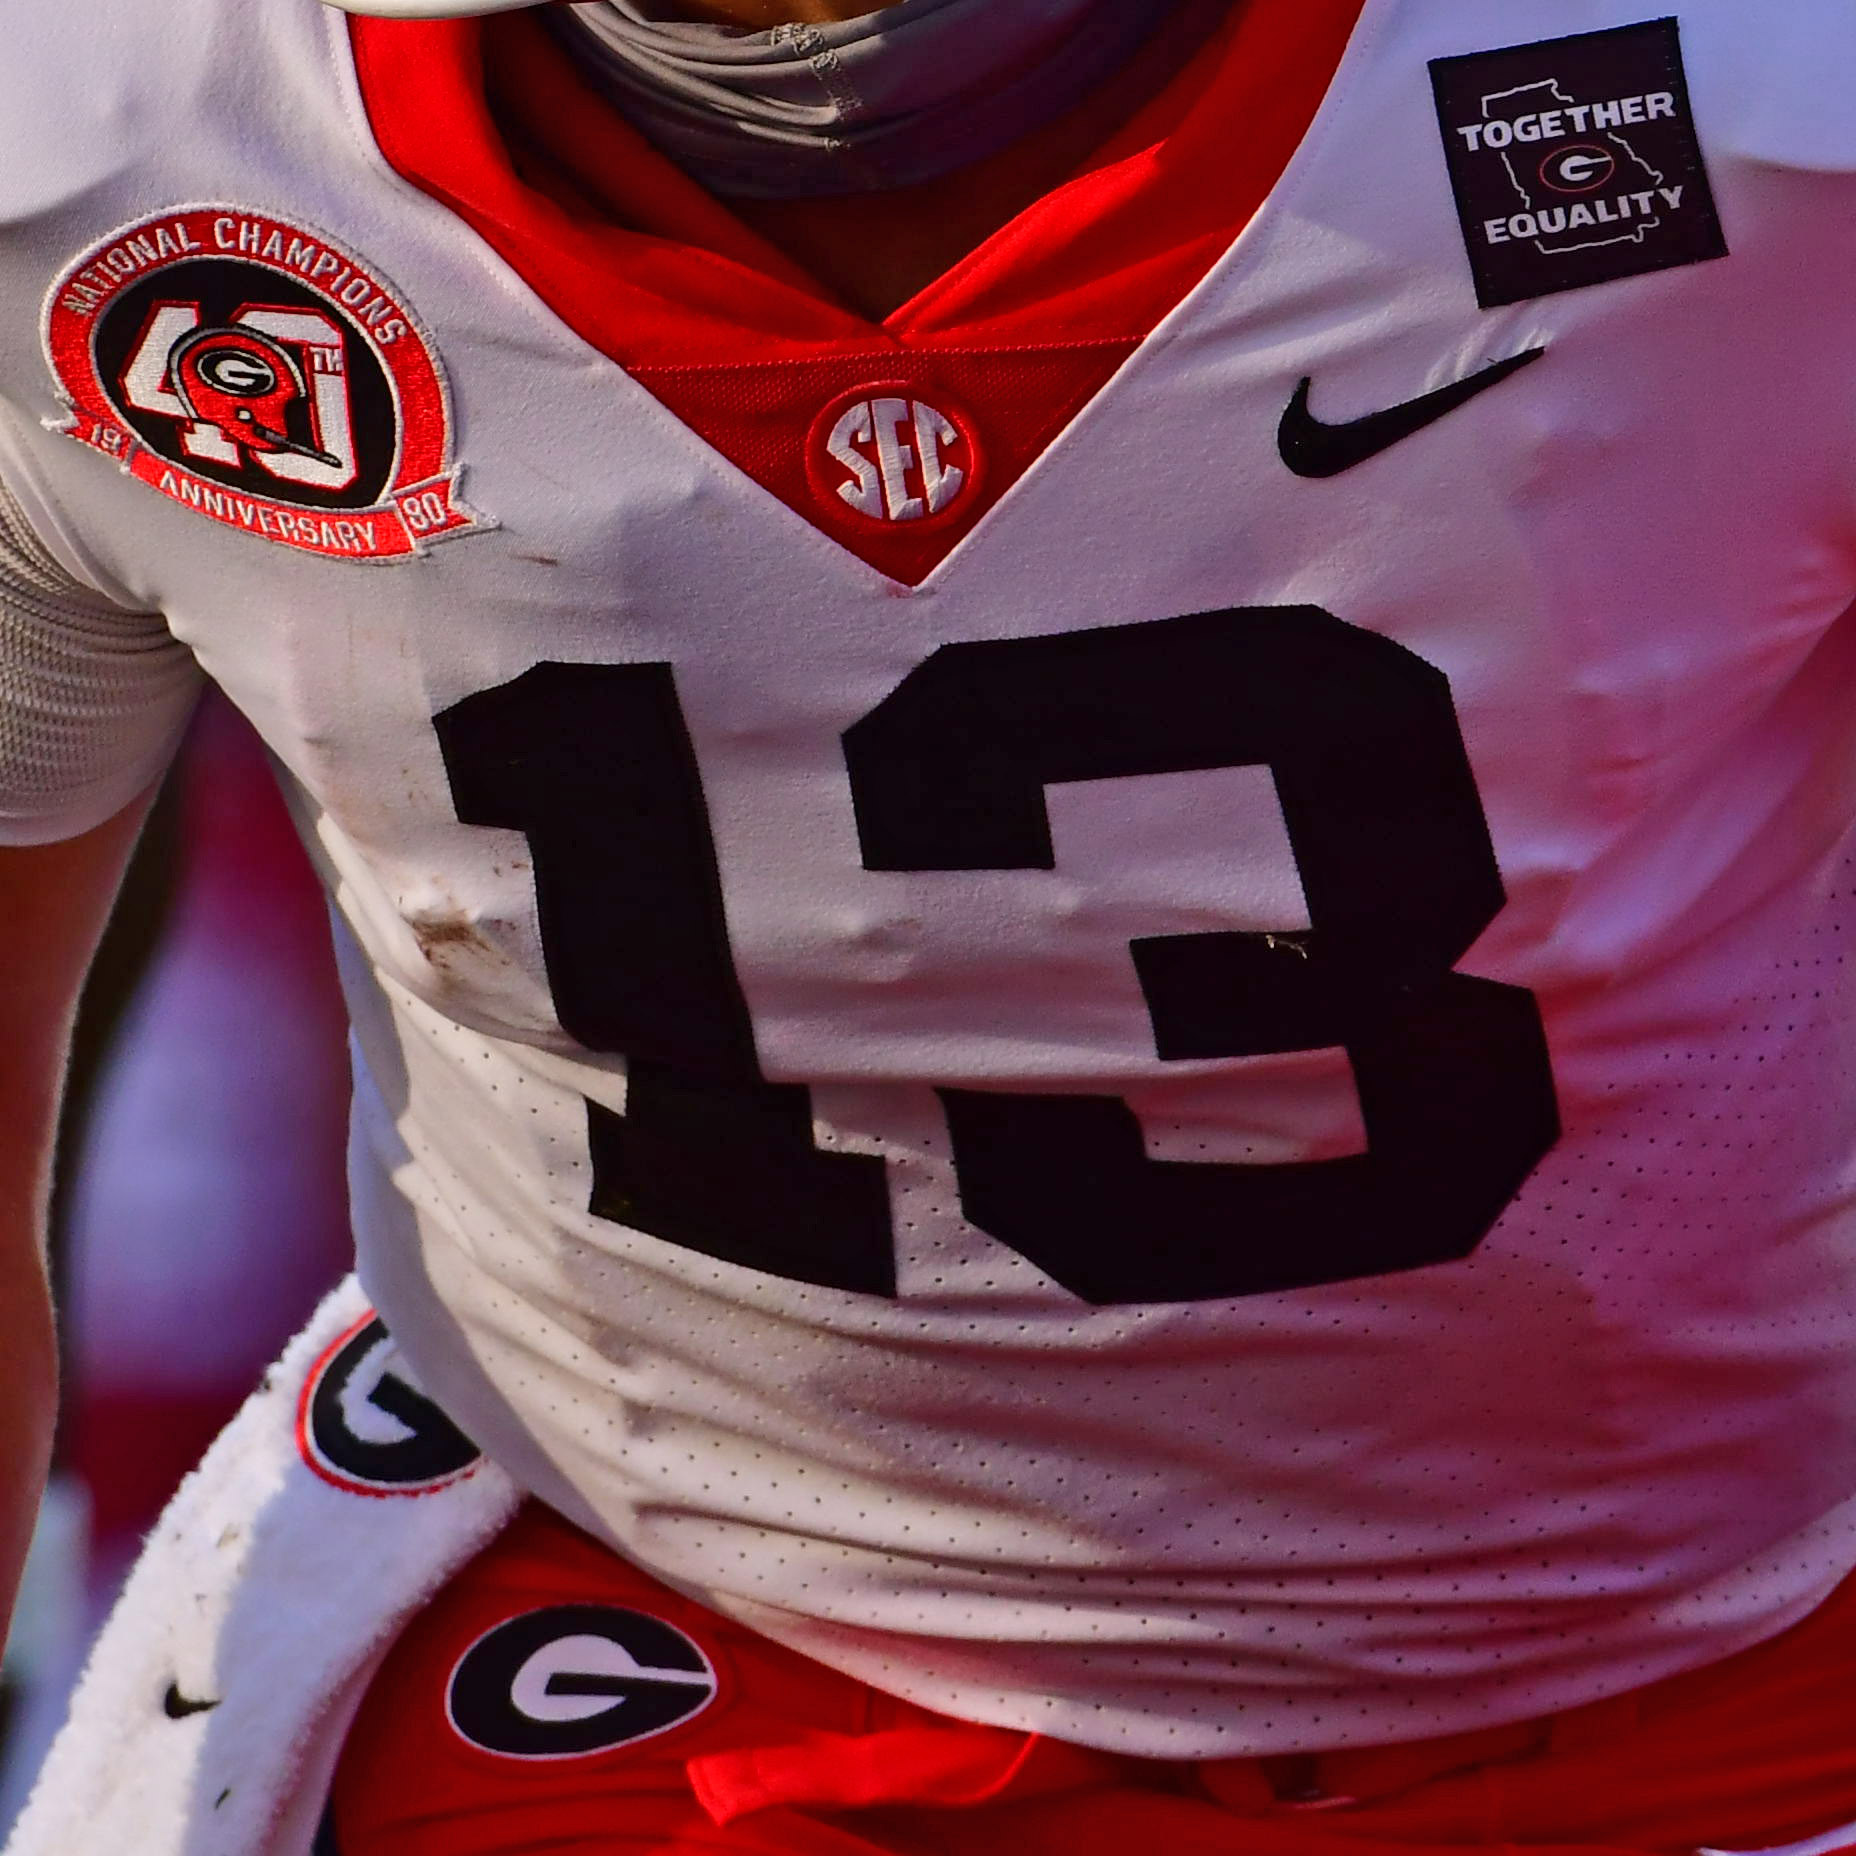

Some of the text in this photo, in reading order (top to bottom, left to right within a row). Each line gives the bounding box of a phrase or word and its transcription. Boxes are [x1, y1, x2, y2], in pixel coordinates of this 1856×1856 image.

[1456, 91, 1677, 152] TOGETHER
[1540, 145, 1615, 192] G
[1482, 184, 1684, 245] EQUALITY
[61, 217, 407, 345] NATIONAL CHAMPIONS
[90, 422, 123, 453] 19
[825, 397, 964, 521] SEC
[159, 469, 377, 552] ANNIVERSARY
[431, 602, 1562, 1307] 13
[447, 1603, 717, 1758] G
